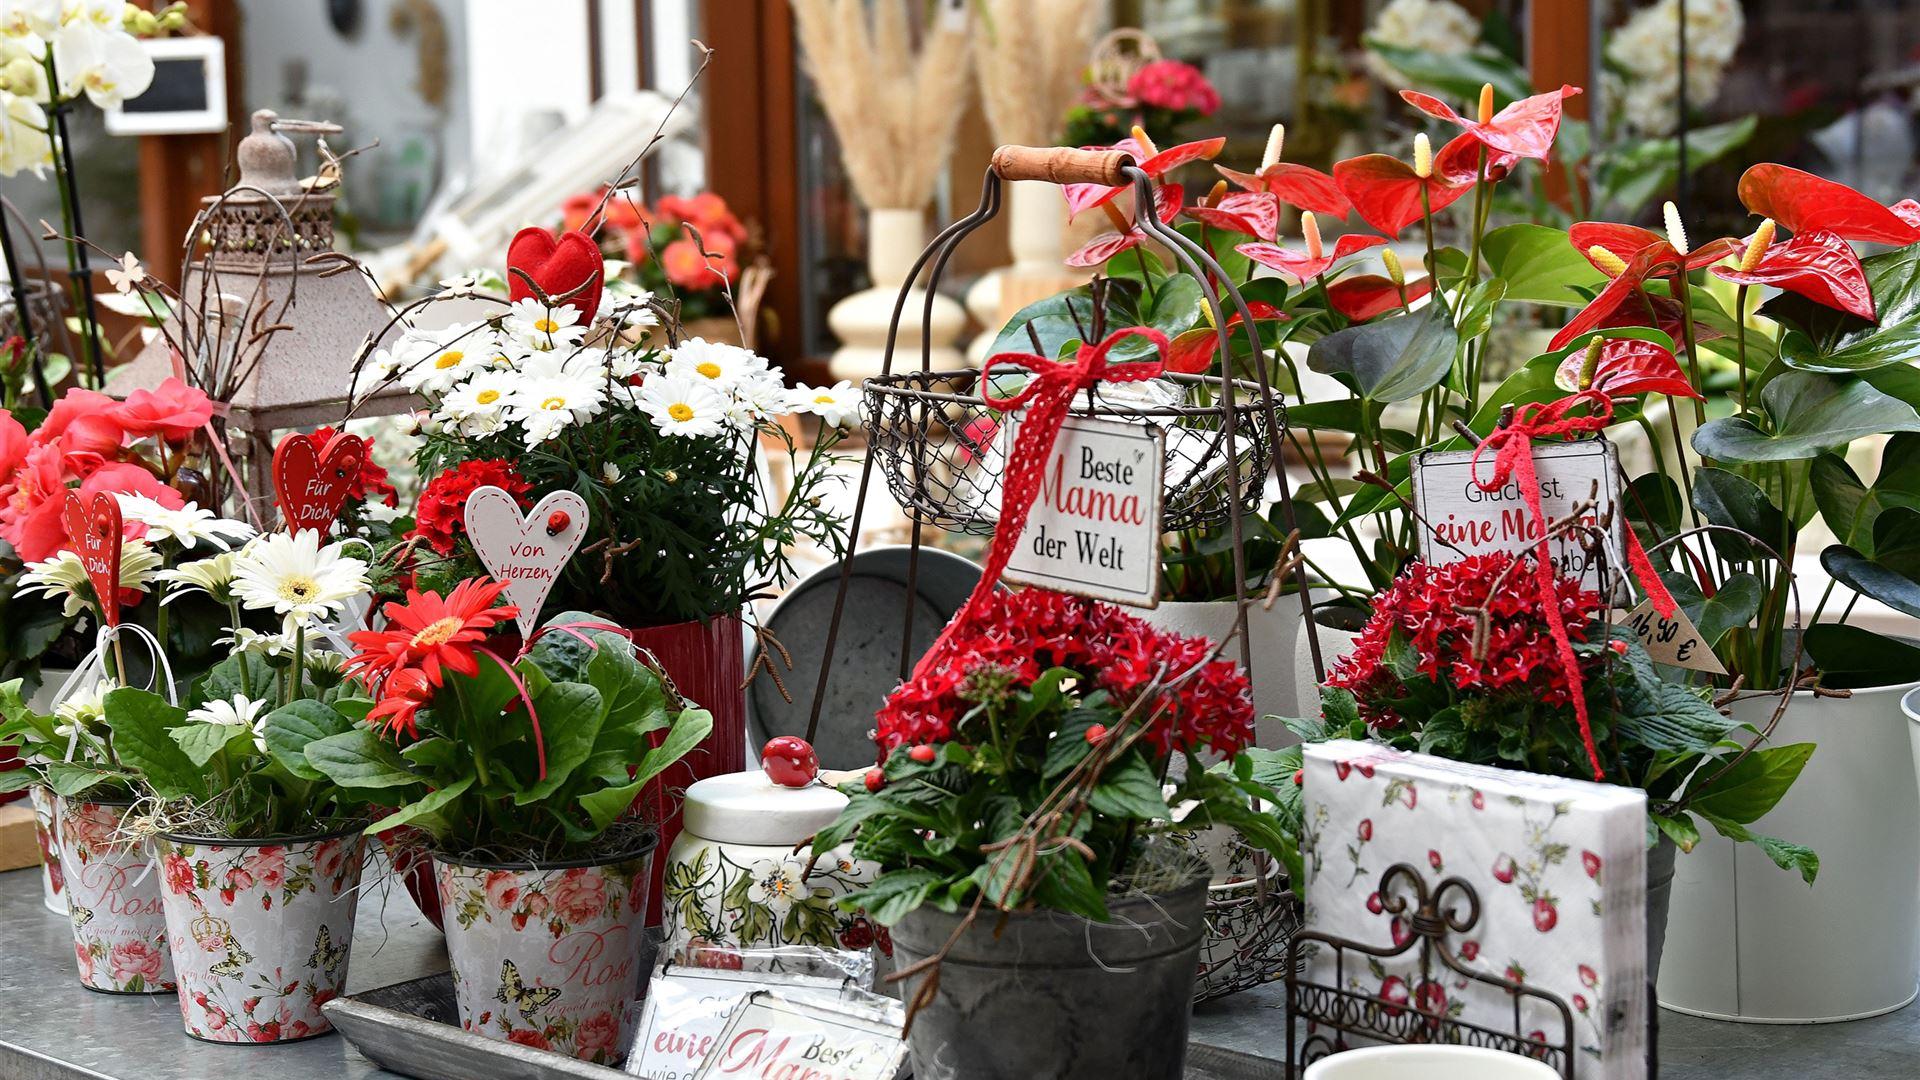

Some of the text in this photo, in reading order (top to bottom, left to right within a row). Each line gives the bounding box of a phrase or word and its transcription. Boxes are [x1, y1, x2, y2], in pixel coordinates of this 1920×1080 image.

[1080, 446, 1133, 485] Beste
[305, 479, 333, 497] Für
[1041, 453, 1146, 525] Mama
[85, 533, 102, 550] Für
[1033, 524, 1124, 571] der Welt
[1436, 514, 1497, 547] eine
[1630, 611, 1697, 661] 16,90 €
